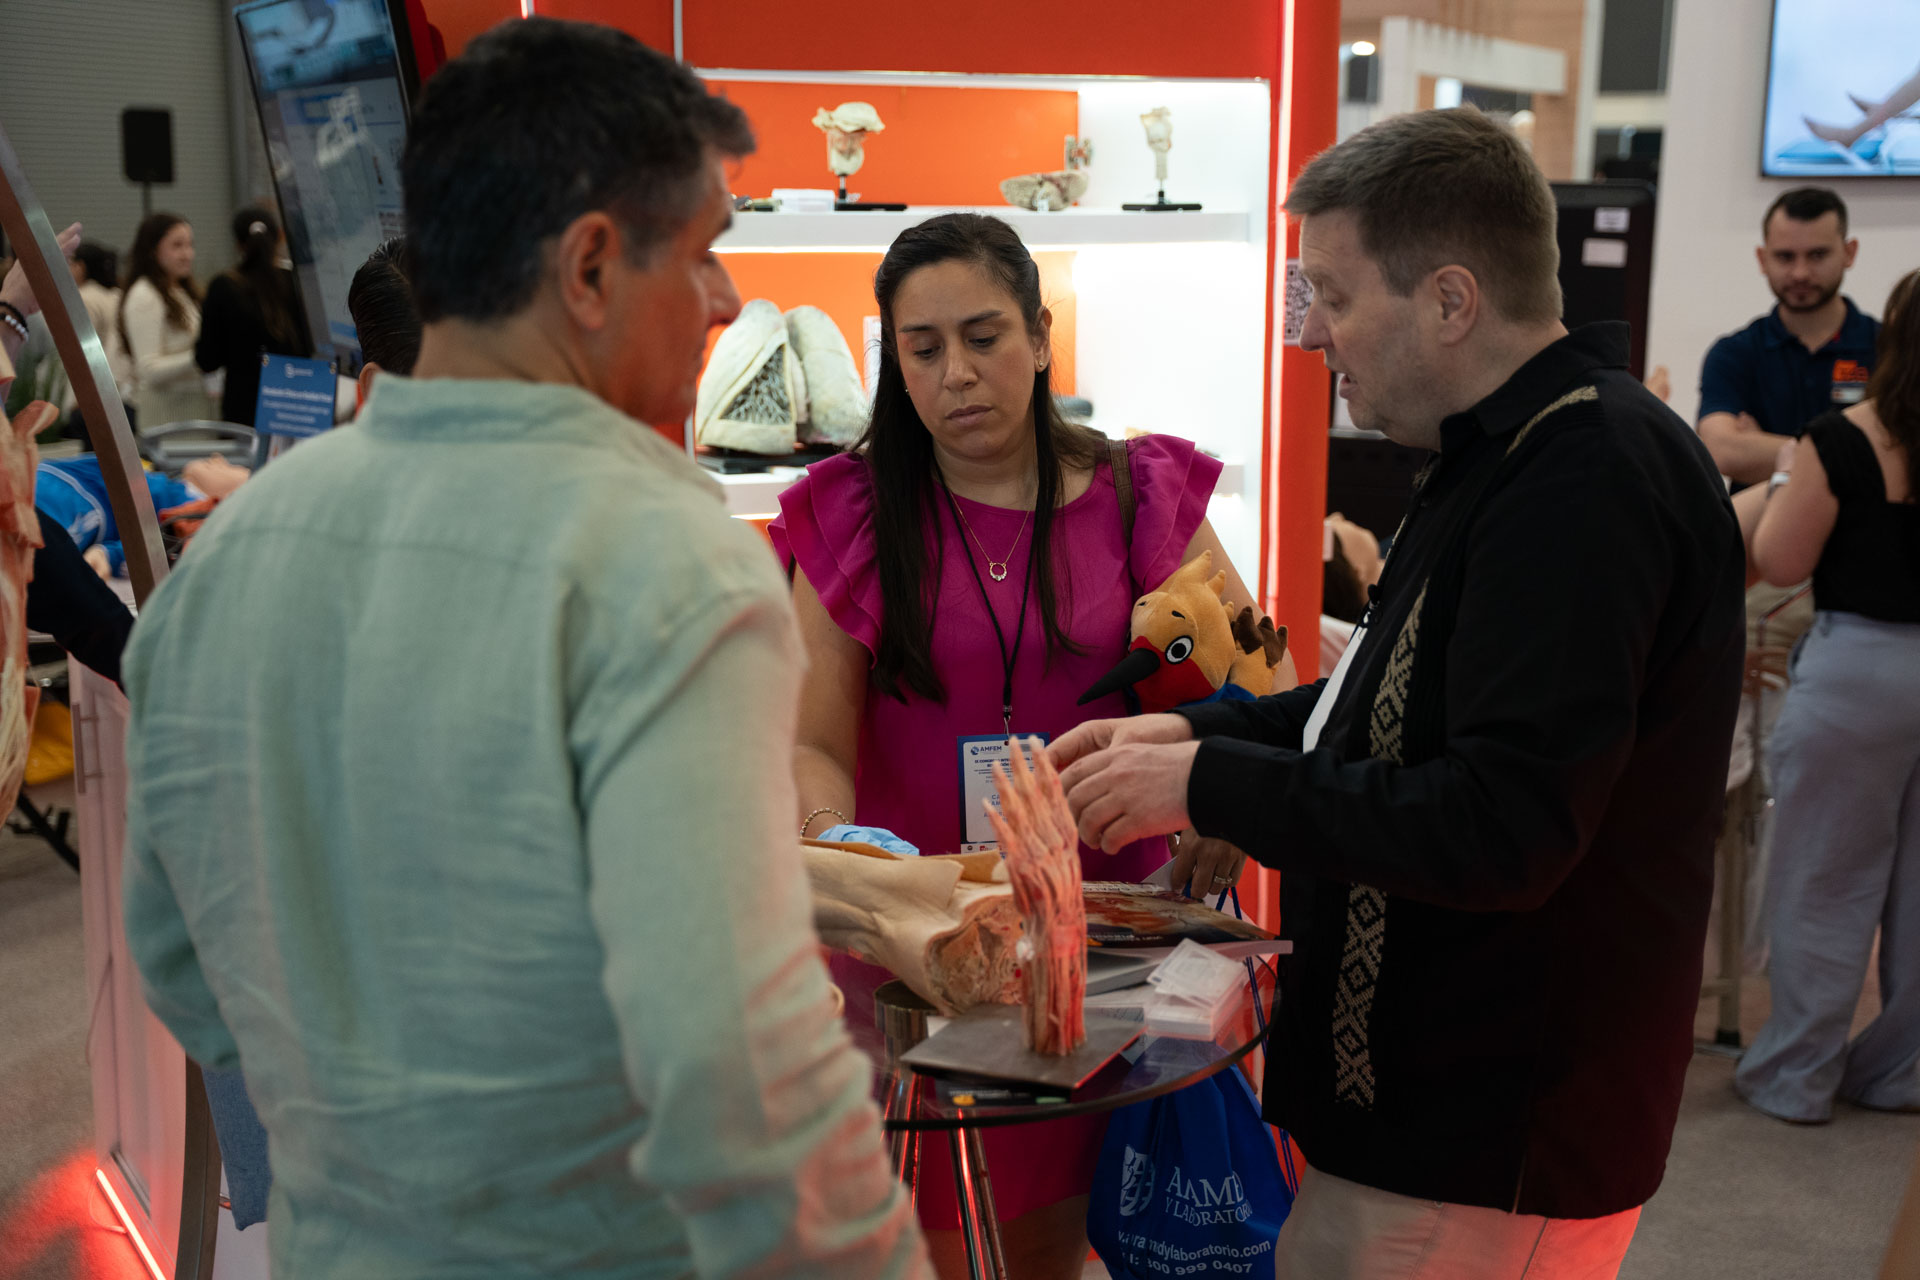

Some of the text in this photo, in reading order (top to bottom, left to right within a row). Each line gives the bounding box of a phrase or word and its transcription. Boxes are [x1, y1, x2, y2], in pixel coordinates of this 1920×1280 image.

[1165, 1196, 1174, 1214] Y
[1174, 1262, 1207, 1276] 999
[1212, 1260, 1253, 1274] 0407
